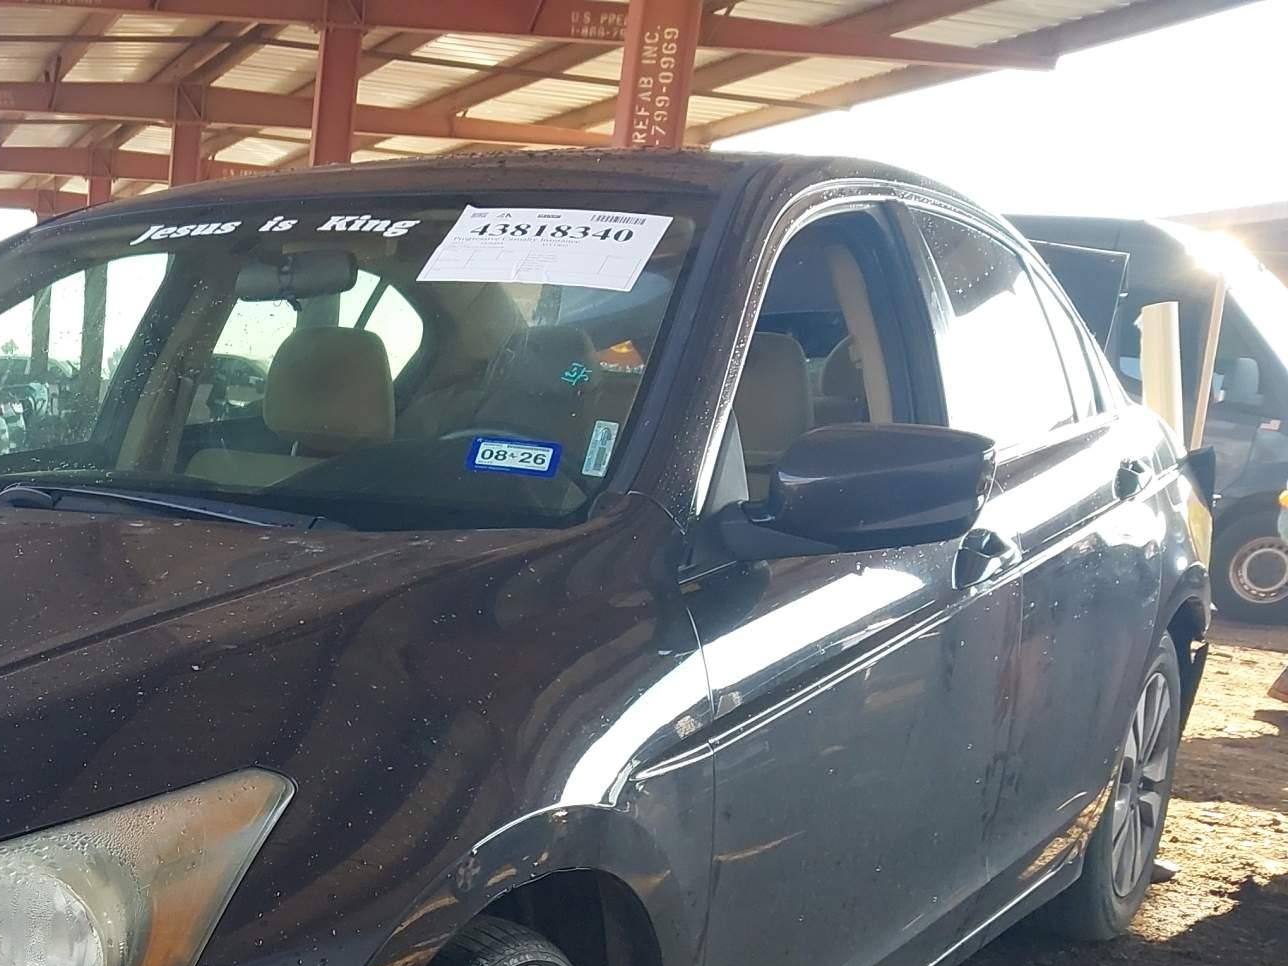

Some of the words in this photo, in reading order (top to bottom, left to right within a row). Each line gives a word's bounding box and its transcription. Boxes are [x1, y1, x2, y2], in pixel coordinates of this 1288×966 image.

[641, 25, 661, 64] INC.
[651, 27, 680, 145] -799-0969
[632, 77, 654, 143] REFAB
[129, 221, 242, 245] Jesus
[258, 215, 298, 232] is
[317, 215, 421, 237] King
[470, 223, 634, 243] 43818340
[481, 449, 508, 461] 08
[518, 452, 547, 465] 26
